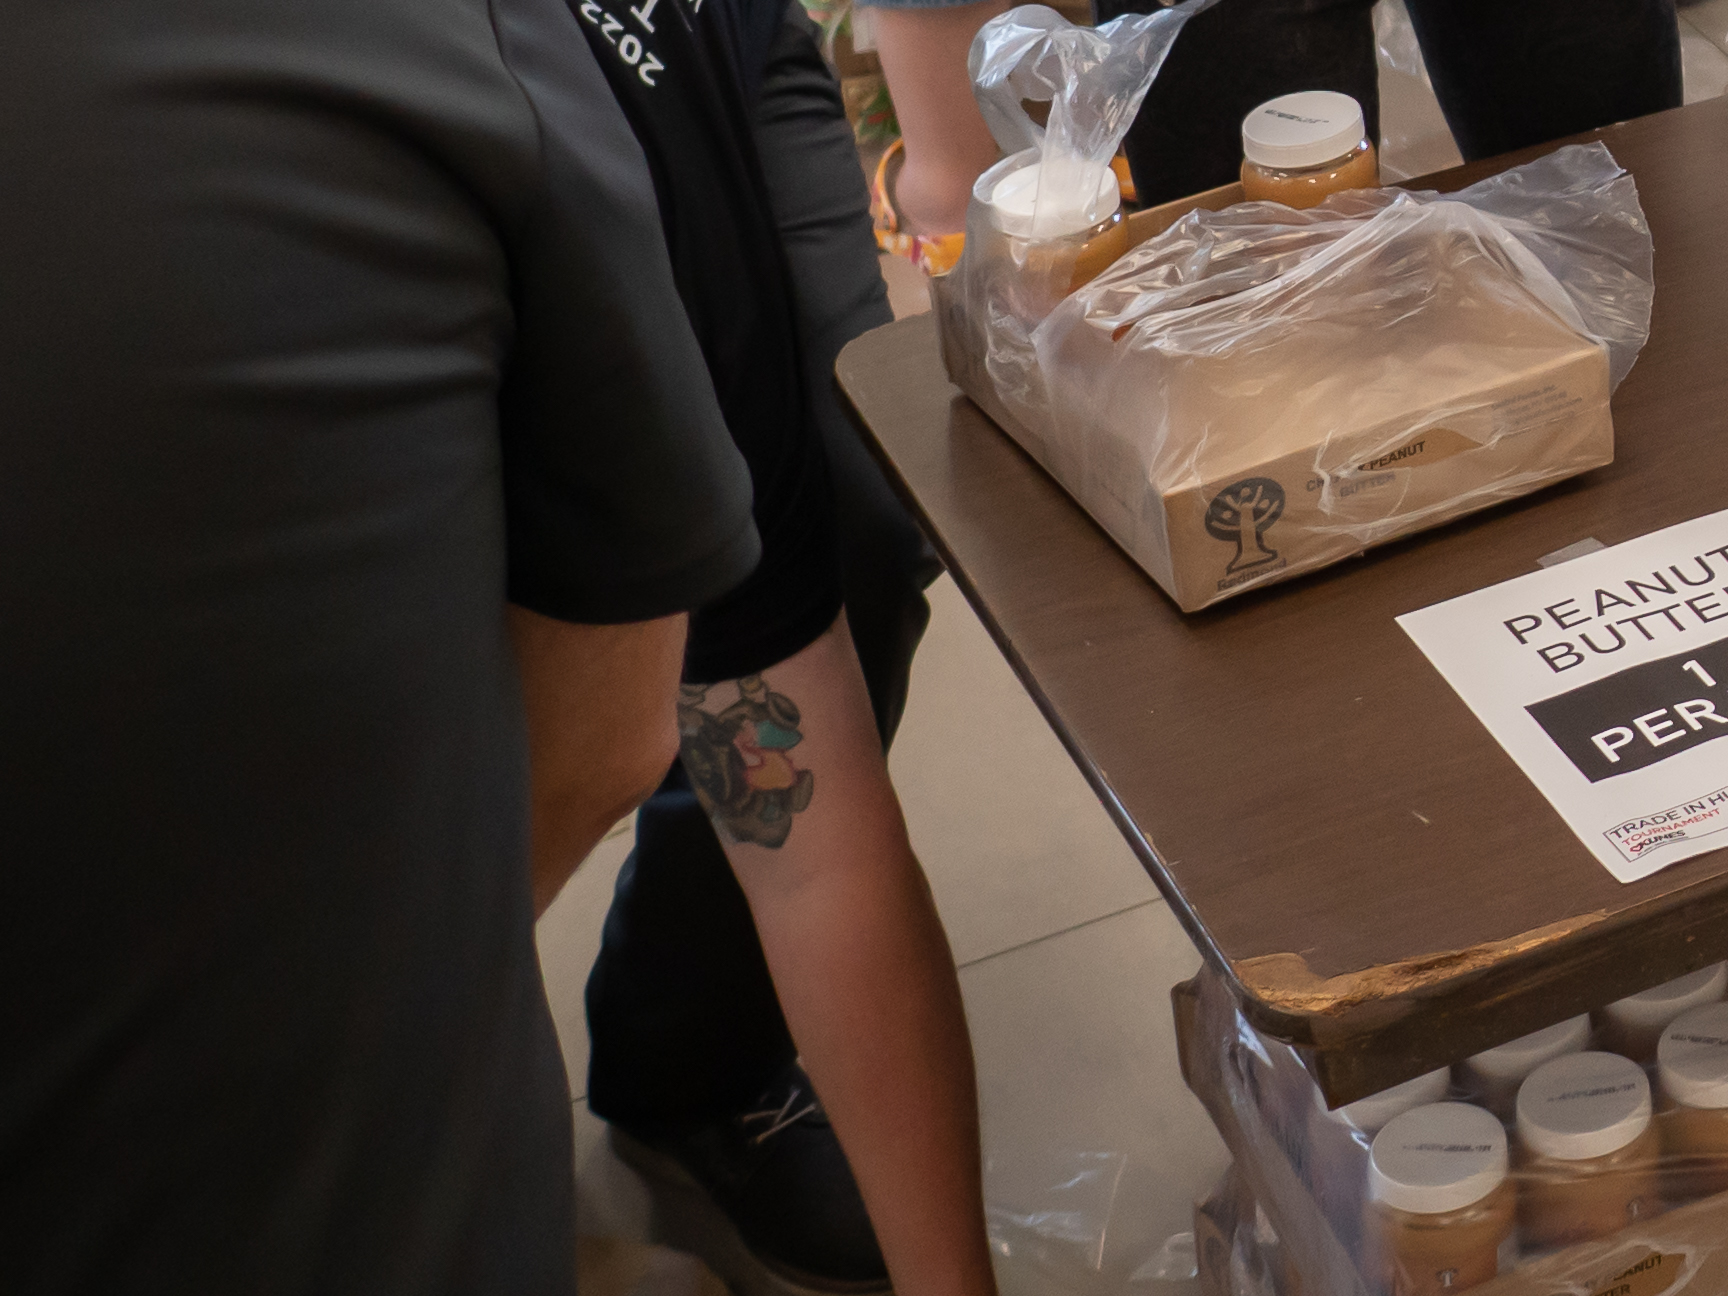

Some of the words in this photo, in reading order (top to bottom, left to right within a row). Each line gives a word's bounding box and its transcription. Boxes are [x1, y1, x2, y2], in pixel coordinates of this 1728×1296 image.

[1369, 440, 1426, 471] PEANUT
[1682, 659, 1717, 688] 1
[1609, 809, 1683, 841] TRADE
[1682, 801, 1707, 817] IN
[1622, 807, 1721, 847] TOURNAMENT
